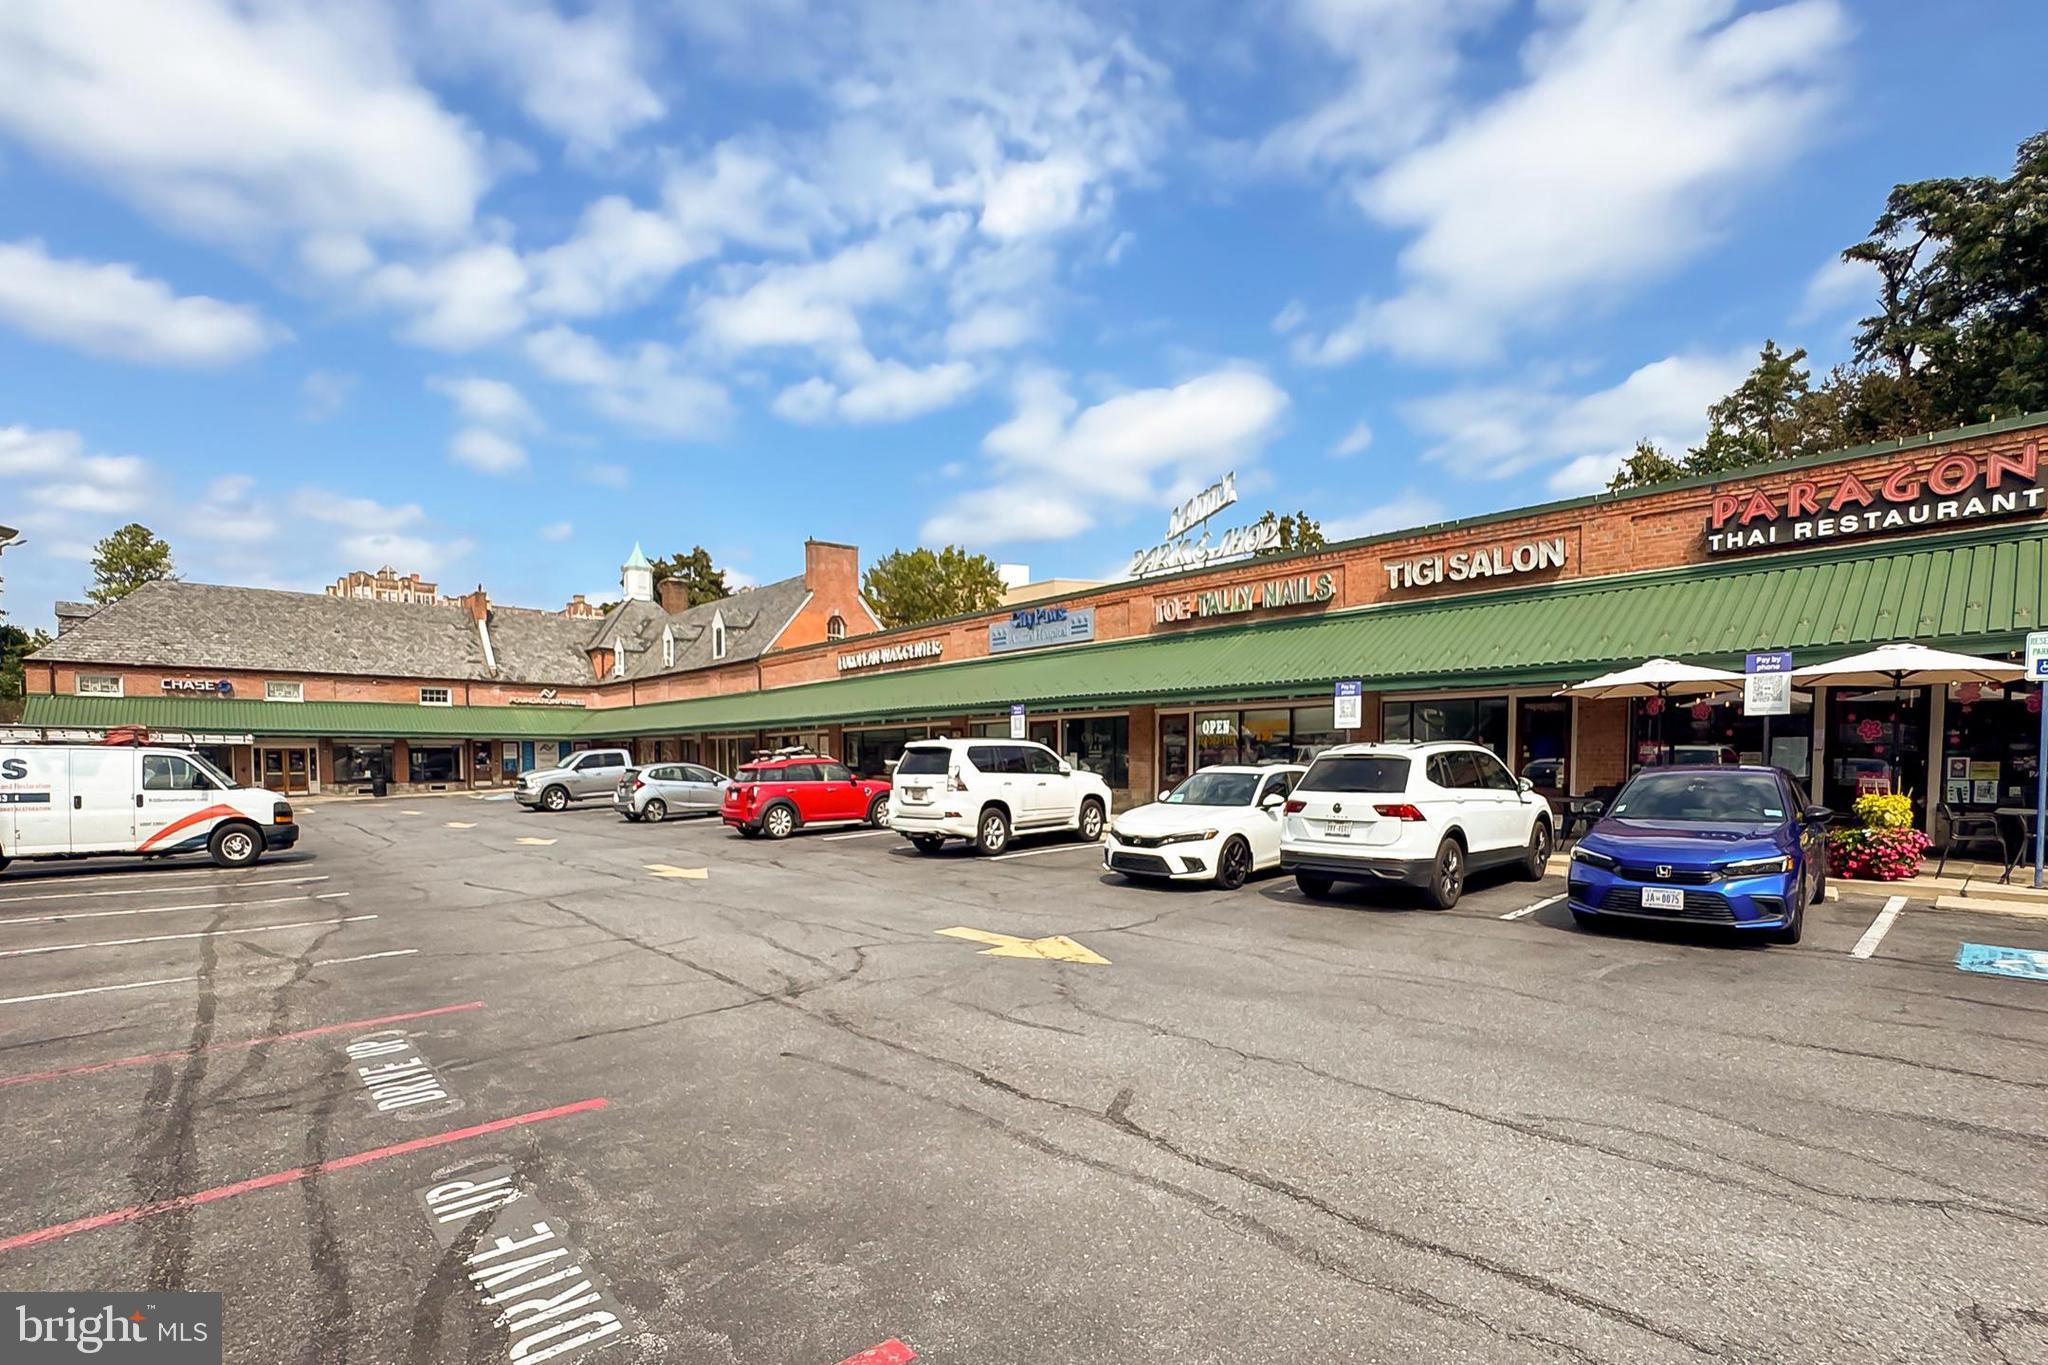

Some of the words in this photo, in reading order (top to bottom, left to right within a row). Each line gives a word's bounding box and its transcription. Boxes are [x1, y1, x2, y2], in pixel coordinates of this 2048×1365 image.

[1711, 440, 2039, 529] PARAGON
[1708, 525, 1776, 550] THAI
[1794, 487, 2046, 540] RESTAURANT
[1384, 555, 1444, 590] TIGI
[1448, 536, 1566, 582] SALON
[1153, 595, 1192, 625] TOE
[1197, 584, 1256, 617] TALLY
[1756, 656, 1770, 664] Pay
[1771, 655, 1781, 663] by
[1756, 664, 1780, 672] phone
[160, 679, 216, 691] CHASE
[1202, 719, 1230, 735] OPEN
[1, 758, 28, 780] S
[1645, 892, 1655, 903] JA
[345, 1038, 409, 1060] UP
[358, 1056, 448, 1112] DRIVE
[425, 1176, 527, 1224] UP
[463, 1221, 624, 1365] DRIVE
